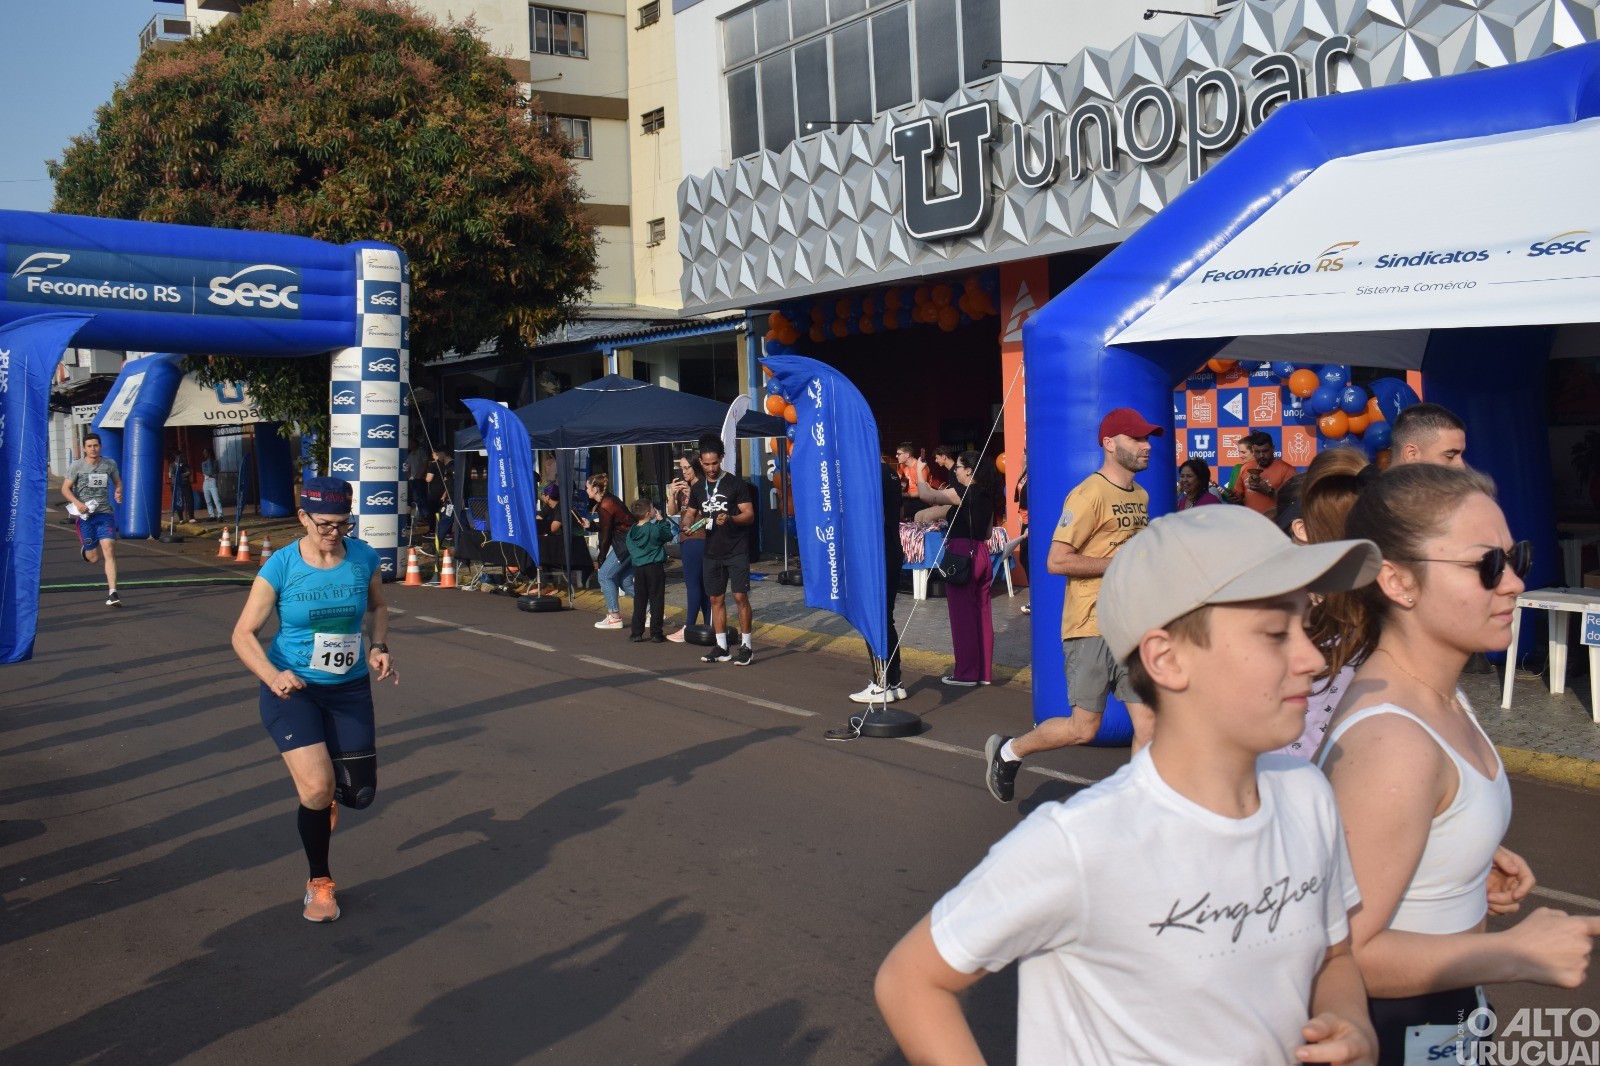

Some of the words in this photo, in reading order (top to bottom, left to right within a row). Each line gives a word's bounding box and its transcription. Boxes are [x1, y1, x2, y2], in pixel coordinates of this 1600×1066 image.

[1012, 34, 1354, 183] unopar
[1201, 261, 1311, 284] Fecomércio
[1315, 257, 1344, 273] RS
[1374, 248, 1490, 270] Sindicatos
[1526, 234, 1591, 258] Sesc
[27, 276, 147, 302] Fecomércio
[153, 284, 182, 303] RS
[207, 268, 299, 310] Sesc
[1355, 283, 1410, 296] Sistema
[1413, 279, 1477, 293] Comércio
[370, 292, 398, 306] Sesc
[367, 359, 397, 373] Sesc
[333, 392, 356, 405] Sesc
[814, 378, 823, 409] Senac
[203, 408, 260, 422] unopa
[1283, 409, 1305, 419] unop
[366, 426, 396, 439] Sesc
[814, 421, 826, 447] Sesc
[1188, 449, 1216, 459] unopar
[332, 458, 355, 472] Sesc
[10, 469, 22, 507] Comércio
[820, 460, 832, 512] Sindicatos
[365, 493, 395, 506] Sesc
[5, 508, 17, 543] Sistema
[1116, 516, 1131, 528] 10
[826, 525, 834, 540] RS
[826, 541, 840, 600] Fecomércio
[323, 639, 342, 648] Sesc
[321, 651, 355, 668] 196
